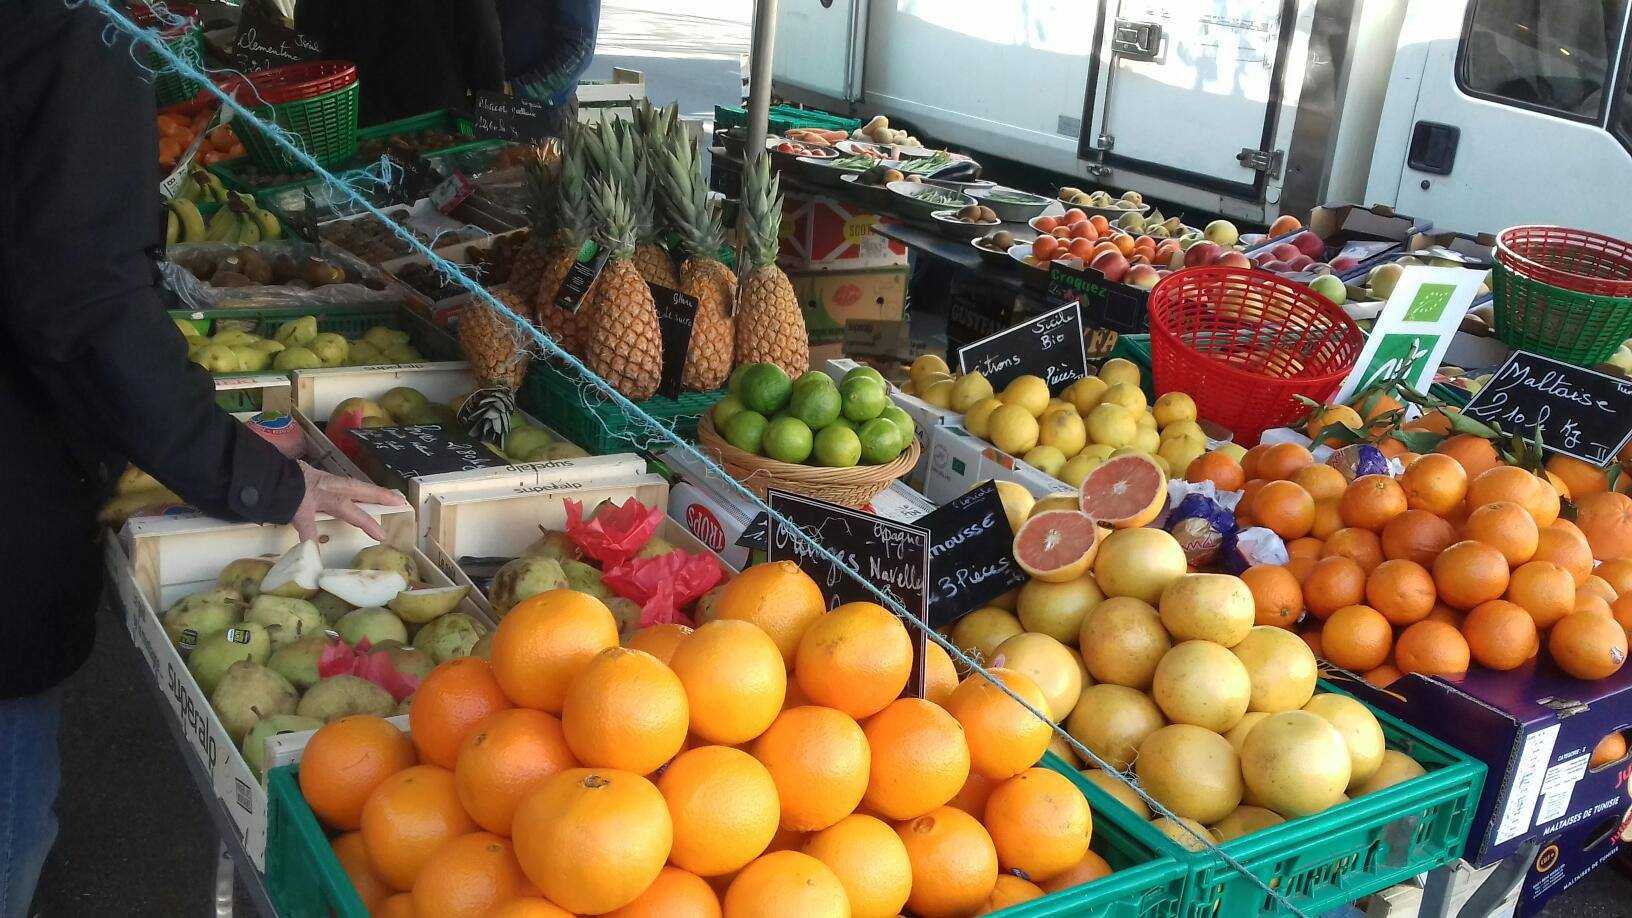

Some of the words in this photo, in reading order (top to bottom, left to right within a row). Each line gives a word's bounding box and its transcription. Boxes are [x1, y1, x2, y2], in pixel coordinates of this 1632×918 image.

[1031, 312, 1076, 334] Sicile
[1040, 333, 1065, 351] Bio
[1496, 361, 1617, 413] Maltaise
[687, 505, 725, 552] TROPS
[928, 512, 995, 560] mousse
